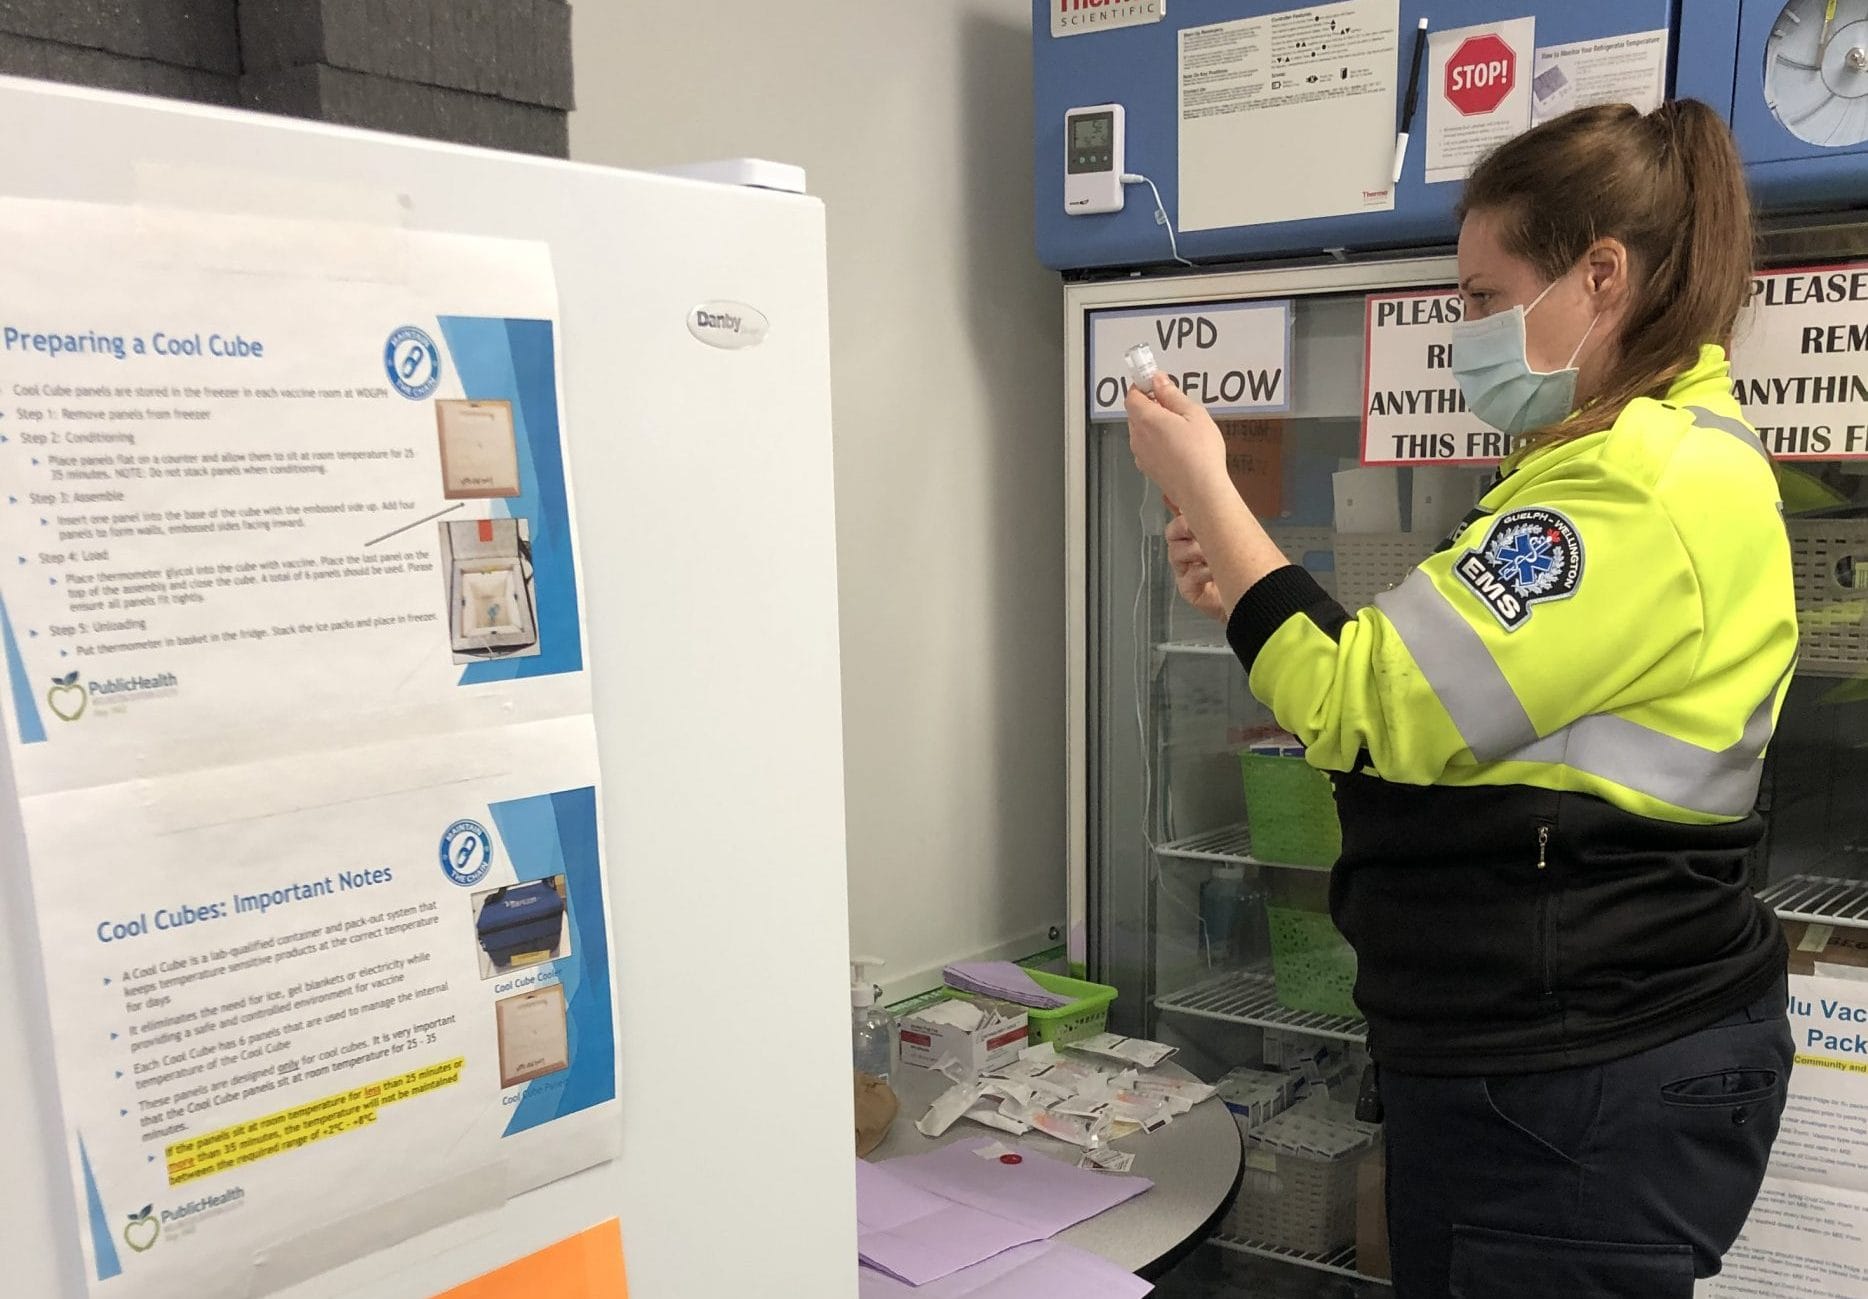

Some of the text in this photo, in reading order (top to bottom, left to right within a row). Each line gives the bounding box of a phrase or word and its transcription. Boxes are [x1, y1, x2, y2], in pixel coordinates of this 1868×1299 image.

[1061, 4, 1154, 27] SCIENTIFIC
[1626, 37, 1661, 47] Temperature
[1452, 59, 1508, 91] STOP!
[696, 310, 742, 333] Danby
[1377, 298, 1462, 327] PLEAS
[4, 327, 263, 359] Preparing a Cool Cube
[1156, 317, 1218, 351] VPD
[1096, 368, 1282, 407] OFLOW
[1369, 388, 1472, 416] ANYTHI
[20, 431, 47, 446] Step
[64, 431, 135, 446] Conditioning
[1392, 432, 1512, 459] THIS FRI
[1755, 425, 1831, 453] THIS
[1503, 511, 1549, 524] GUELPH
[1554, 519, 1579, 589] WELLINGTON
[1461, 556, 1521, 619] EMS
[88, 672, 178, 695] PublicHealth
[97, 866, 393, 942] Cool Cubes: Important Notes
[122, 900, 436, 981] A Cool Cube is a lab-qualified container and pack-out system that
[123, 915, 438, 997] keeps temperature sensitive products at the correct temperature
[128, 1025, 137, 1035] It
[140, 1012, 197, 1032] eliminates
[199, 1006, 218, 1018] the
[220, 998, 246, 1012] need
[248, 995, 263, 1005] for
[287, 983, 302, 998] gel
[304, 974, 344, 991] blankets
[346, 971, 355, 981] or
[358, 959, 404, 977] electricity
[406, 952, 430, 965] while
[495, 981, 513, 993] Cool
[515, 976, 535, 988] Cube
[125, 997, 170, 1011] for days
[1789, 996, 1812, 1016] lu
[133, 981, 448, 1074] Each Cool Cube has 6 panels that are used to manage the internal
[1807, 1028, 1868, 1055] Pack
[135, 1040, 290, 1089] temperature of the Cool Cube
[139, 1096, 170, 1111] These
[173, 1085, 208, 1104] panels
[210, 1080, 228, 1091] are
[230, 1065, 275, 1085] designed
[277, 1059, 299, 1072] only
[301, 1055, 315, 1065] for
[318, 1047, 338, 1060] cool
[372, 1035, 380, 1045] It
[382, 1033, 390, 1042] is
[392, 1027, 411, 1039] very
[412, 1013, 455, 1034] important
[1794, 1055, 1867, 1073] Community and
[140, 1112, 163, 1126] that
[165, 1107, 184, 1119] the
[186, 1098, 211, 1113] Cool
[213, 1092, 239, 1106] Cube
[242, 1082, 275, 1100] panels
[276, 1076, 289, 1087] sit
[291, 1072, 302, 1083] at
[304, 1066, 329, 1080] room
[331, 1047, 389, 1071] temperature
[391, 1043, 403, 1053] for
[407, 1037, 417, 1048] 25
[426, 1031, 436, 1042] 35
[502, 1092, 520, 1105] Cool
[161, 1187, 245, 1223] PublicHealth
